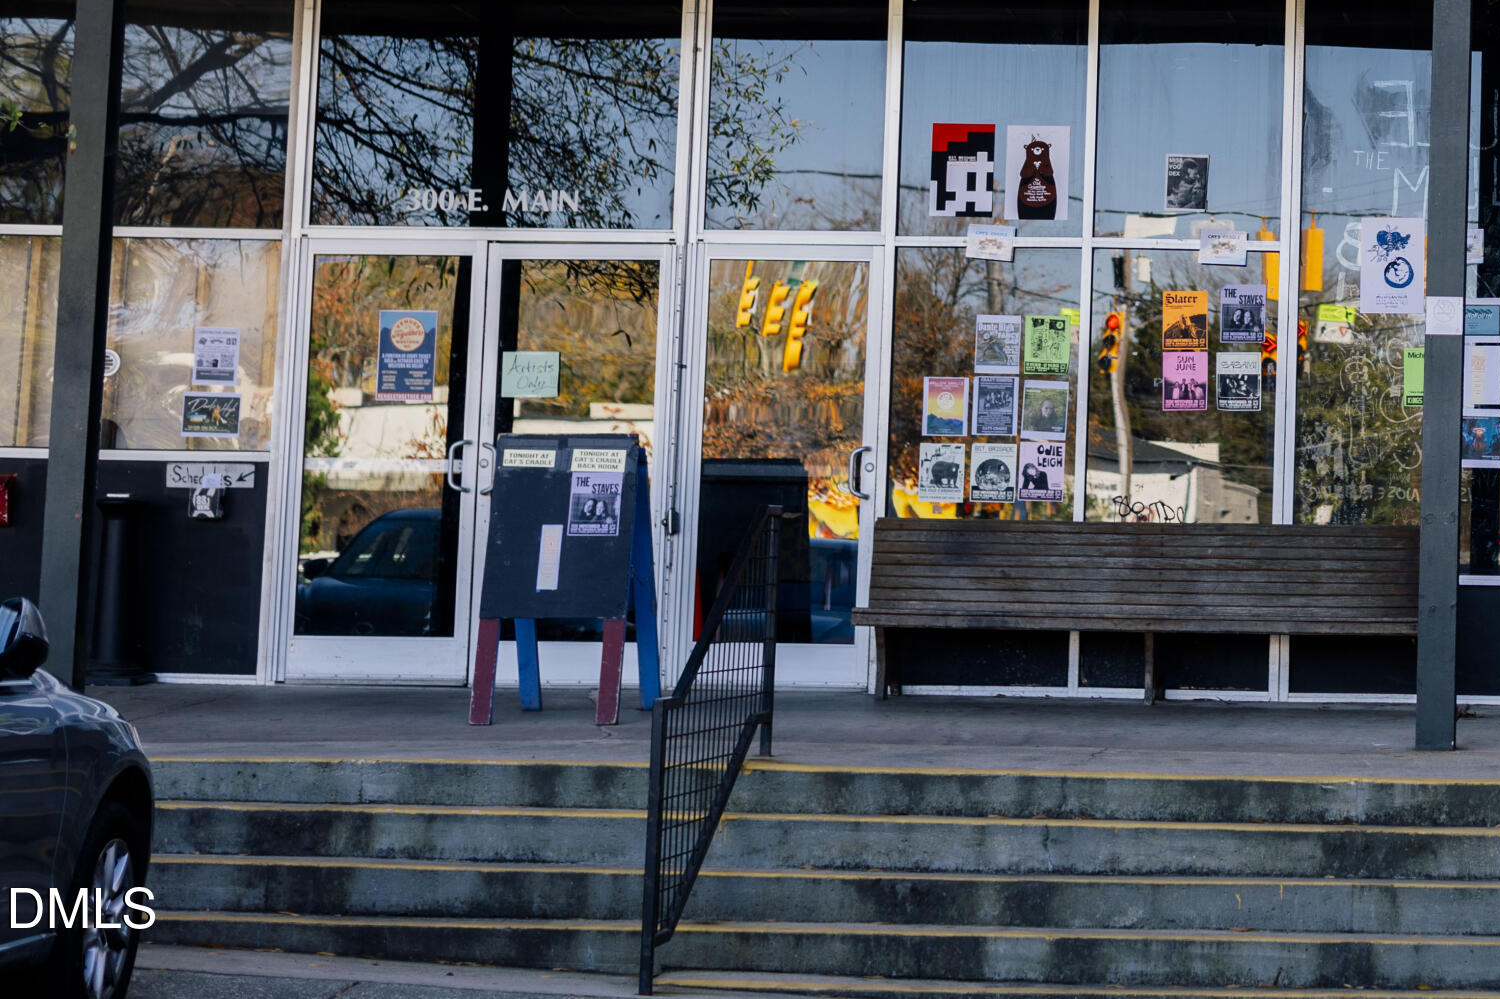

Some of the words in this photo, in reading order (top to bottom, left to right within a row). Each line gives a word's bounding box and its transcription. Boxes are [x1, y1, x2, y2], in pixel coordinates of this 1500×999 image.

[502, 187, 579, 212] MAIN
[1224, 288, 1237, 298] THE
[507, 353, 554, 375] Artists
[1177, 355, 1195, 363] SUN
[1175, 363, 1196, 371] JUNE
[516, 375, 552, 392] Only
[1037, 456, 1063, 468] LEIGH
[576, 476, 591, 487] THE
